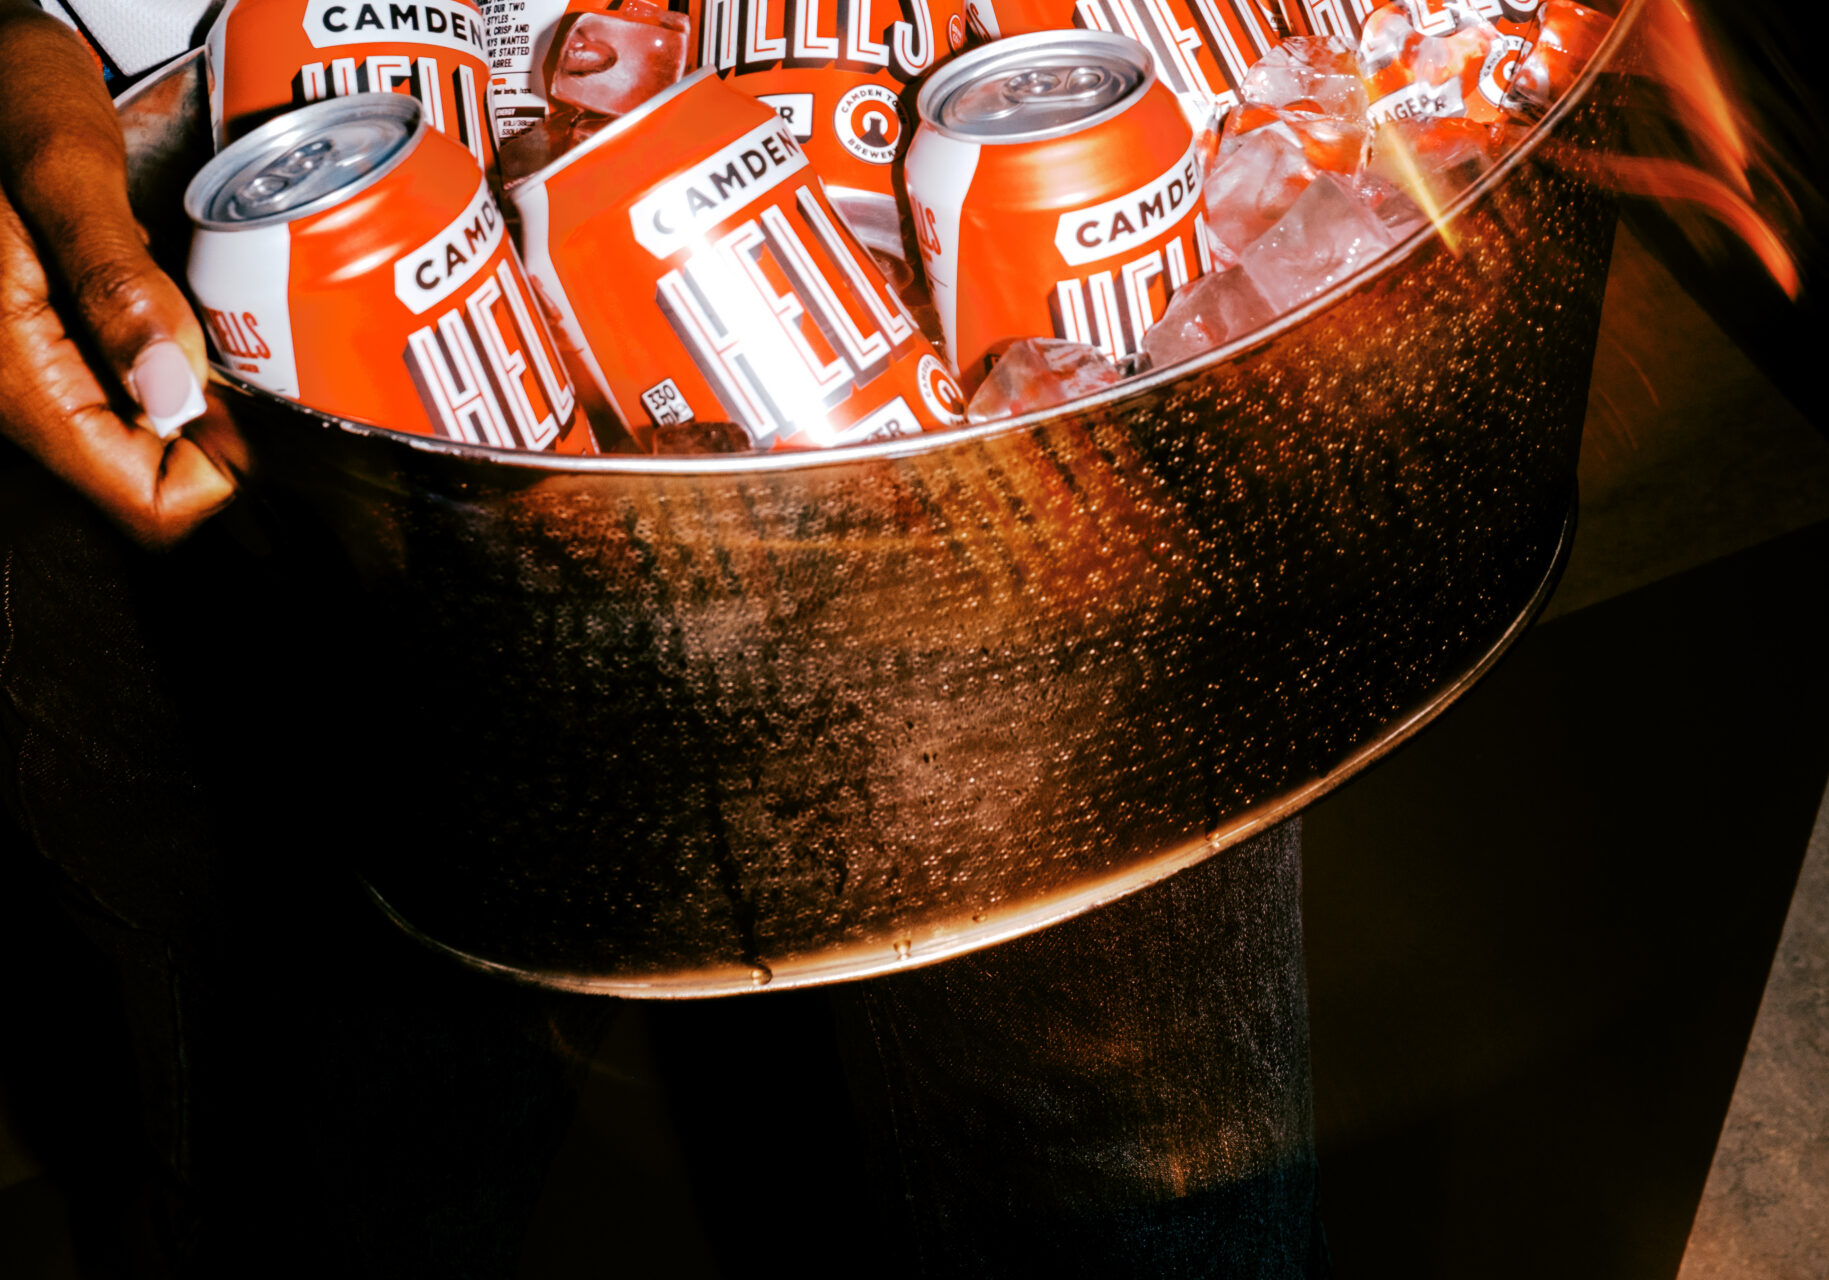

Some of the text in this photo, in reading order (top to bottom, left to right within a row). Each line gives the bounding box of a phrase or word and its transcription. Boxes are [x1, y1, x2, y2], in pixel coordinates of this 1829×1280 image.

[494, 4, 506, 14] OUR
[509, 2, 525, 12] TWO
[487, 14, 509, 26] STYLES
[322, 3, 484, 51] CAMDEN
[515, 24, 530, 34] AND
[499, 47, 530, 58] STARTED
[656, 184, 921, 442] HELL
[647, 384, 676, 410] 330
